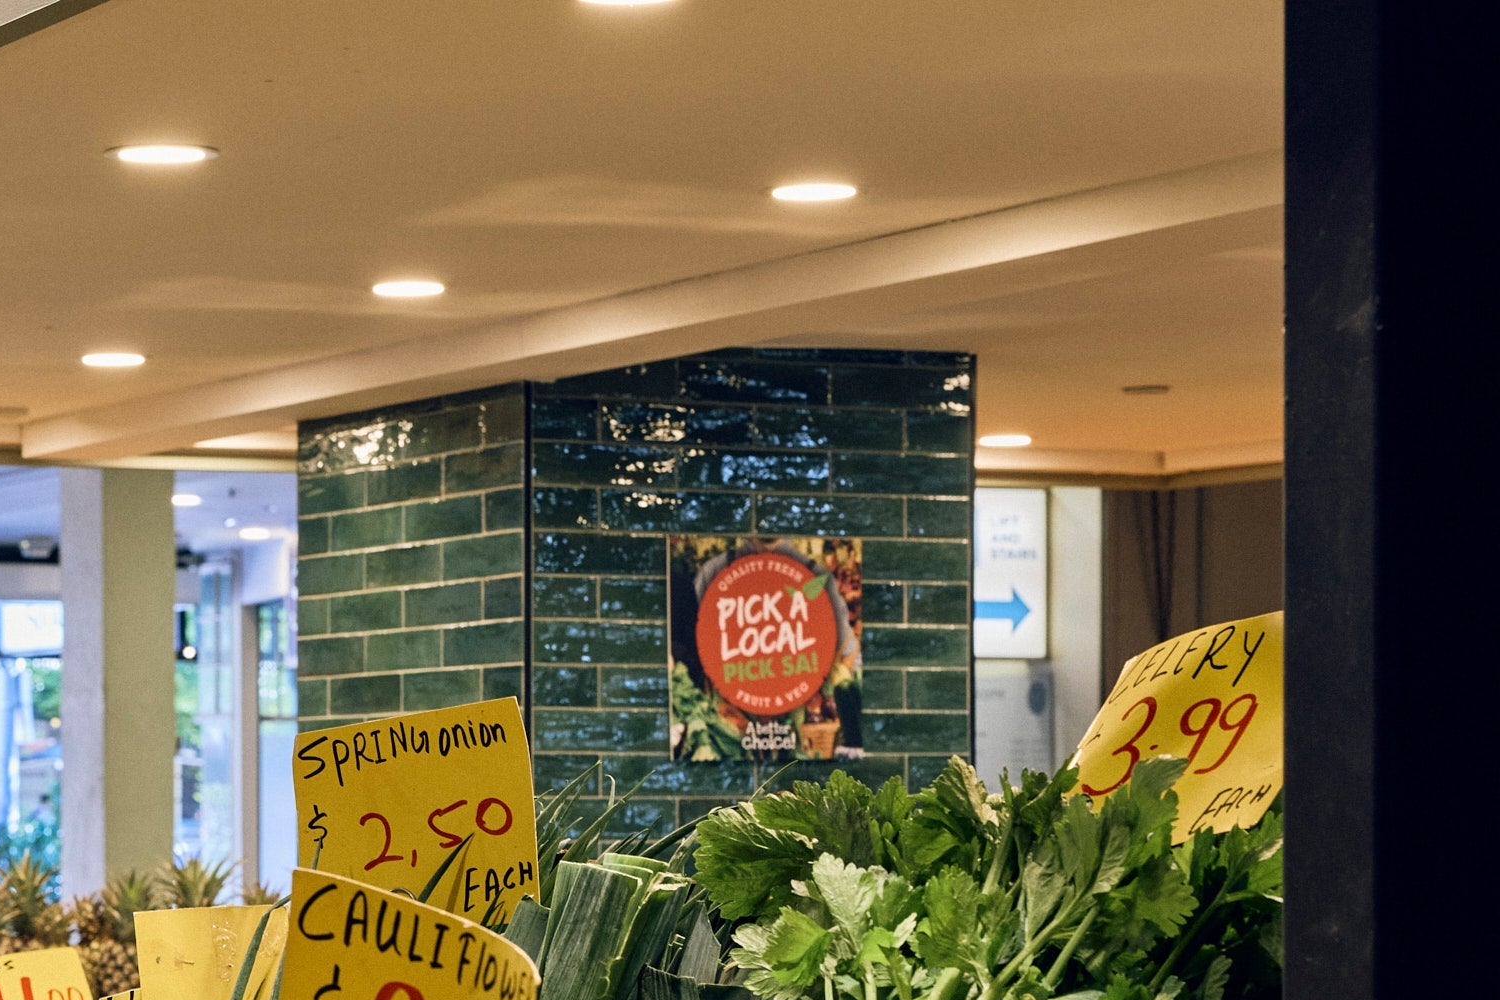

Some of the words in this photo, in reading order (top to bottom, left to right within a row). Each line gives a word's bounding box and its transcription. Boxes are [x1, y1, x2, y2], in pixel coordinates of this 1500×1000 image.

[717, 590, 784, 632] PICK
[789, 591, 809, 622] A
[721, 620, 817, 661] LOCAL
[723, 658, 775, 684] PICK
[781, 652, 819, 676] SA!
[1108, 625, 1266, 704] CELERY
[1188, 784, 1272, 836] EACH
[464, 861, 533, 913] EACH
